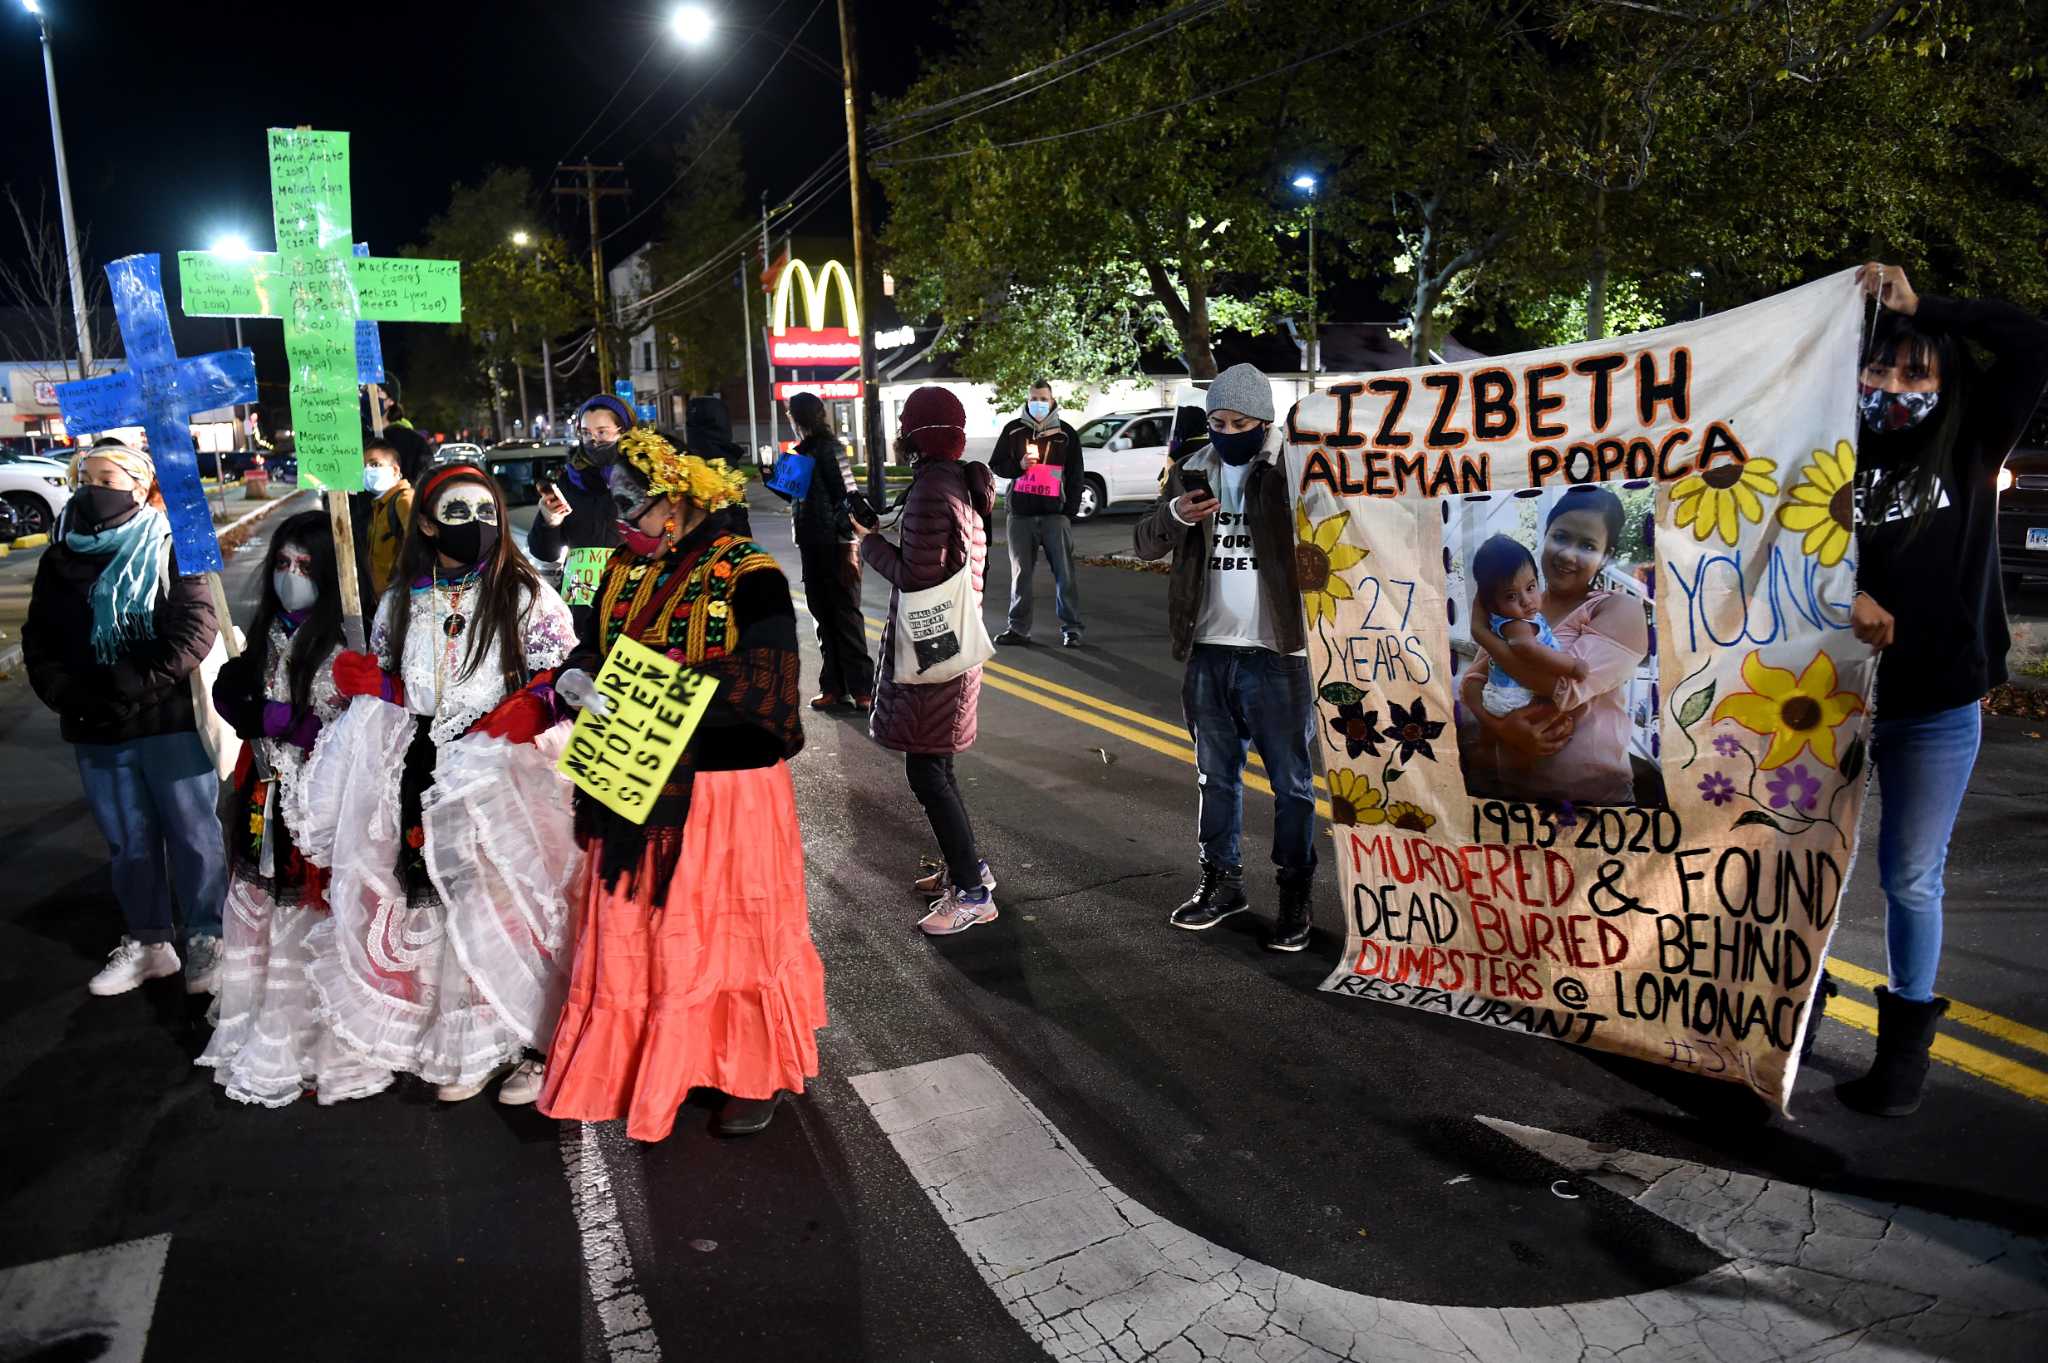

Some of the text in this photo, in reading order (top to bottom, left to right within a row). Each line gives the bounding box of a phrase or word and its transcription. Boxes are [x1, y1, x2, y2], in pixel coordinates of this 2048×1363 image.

[1287, 345, 1693, 449] LIZZBETH
[1299, 419, 1749, 499] ALEMAN POPOCA
[1213, 534, 1250, 549] FOR
[1358, 577, 1415, 632] 27
[1669, 543, 1855, 653] YOUNG
[1328, 635, 1430, 685] YEARS
[565, 736, 596, 778] NO
[586, 664, 670, 792] STOLEN
[617, 666, 705, 806] SISTERS
[1350, 833, 1841, 932] MURDERED & FOUND
[1353, 883, 1812, 992] DEAD BURIED BEHIND
[1353, 939, 1543, 1001] DUMPSTERS
[1553, 976, 1589, 1010] @
[1332, 975, 1609, 1044] RESTAURANT
